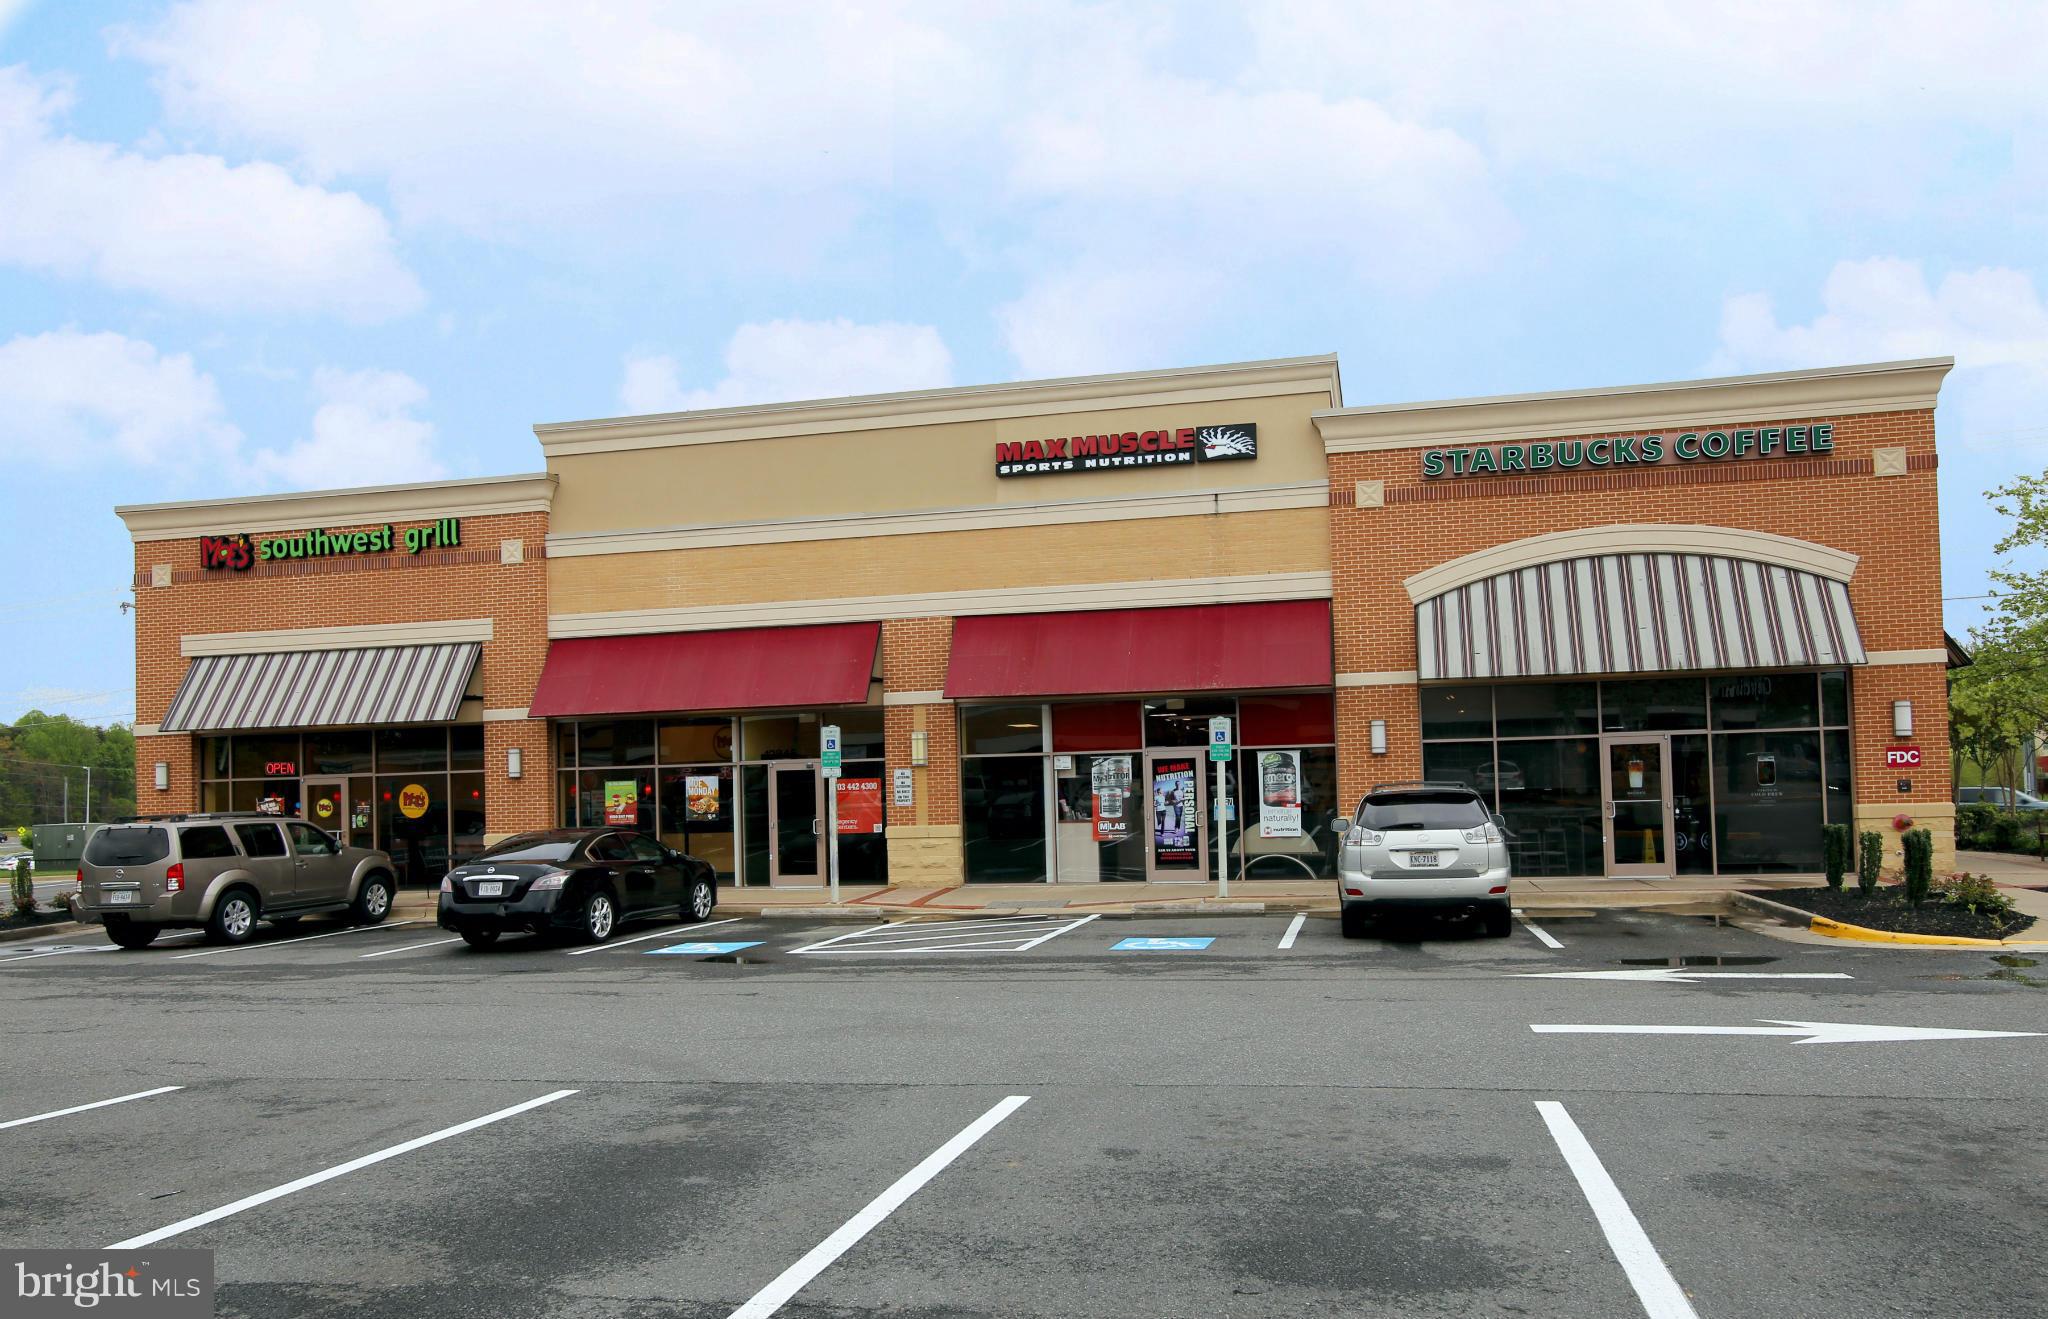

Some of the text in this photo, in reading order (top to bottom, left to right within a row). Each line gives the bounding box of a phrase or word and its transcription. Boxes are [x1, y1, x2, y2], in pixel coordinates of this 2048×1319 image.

[996, 427, 1195, 463] MAX MUSCLE
[1422, 423, 1835, 476] STARBUCKS COFFEE
[999, 451, 1190, 475] SPORTS NUTRITION
[259, 524, 392, 560] southwest
[404, 518, 459, 554] grill
[1887, 750, 1920, 764] FDC
[266, 762, 295, 775] OPEN
[1157, 762, 1190, 774] WE MAKE
[1155, 770, 1194, 782] NUTRITION
[687, 787, 718, 797] MONDAY
[847, 782, 860, 791] 442
[860, 782, 878, 790] 4300
[1183, 780, 1196, 834] PERSONAL
[1263, 813, 1299, 824] naturally!
